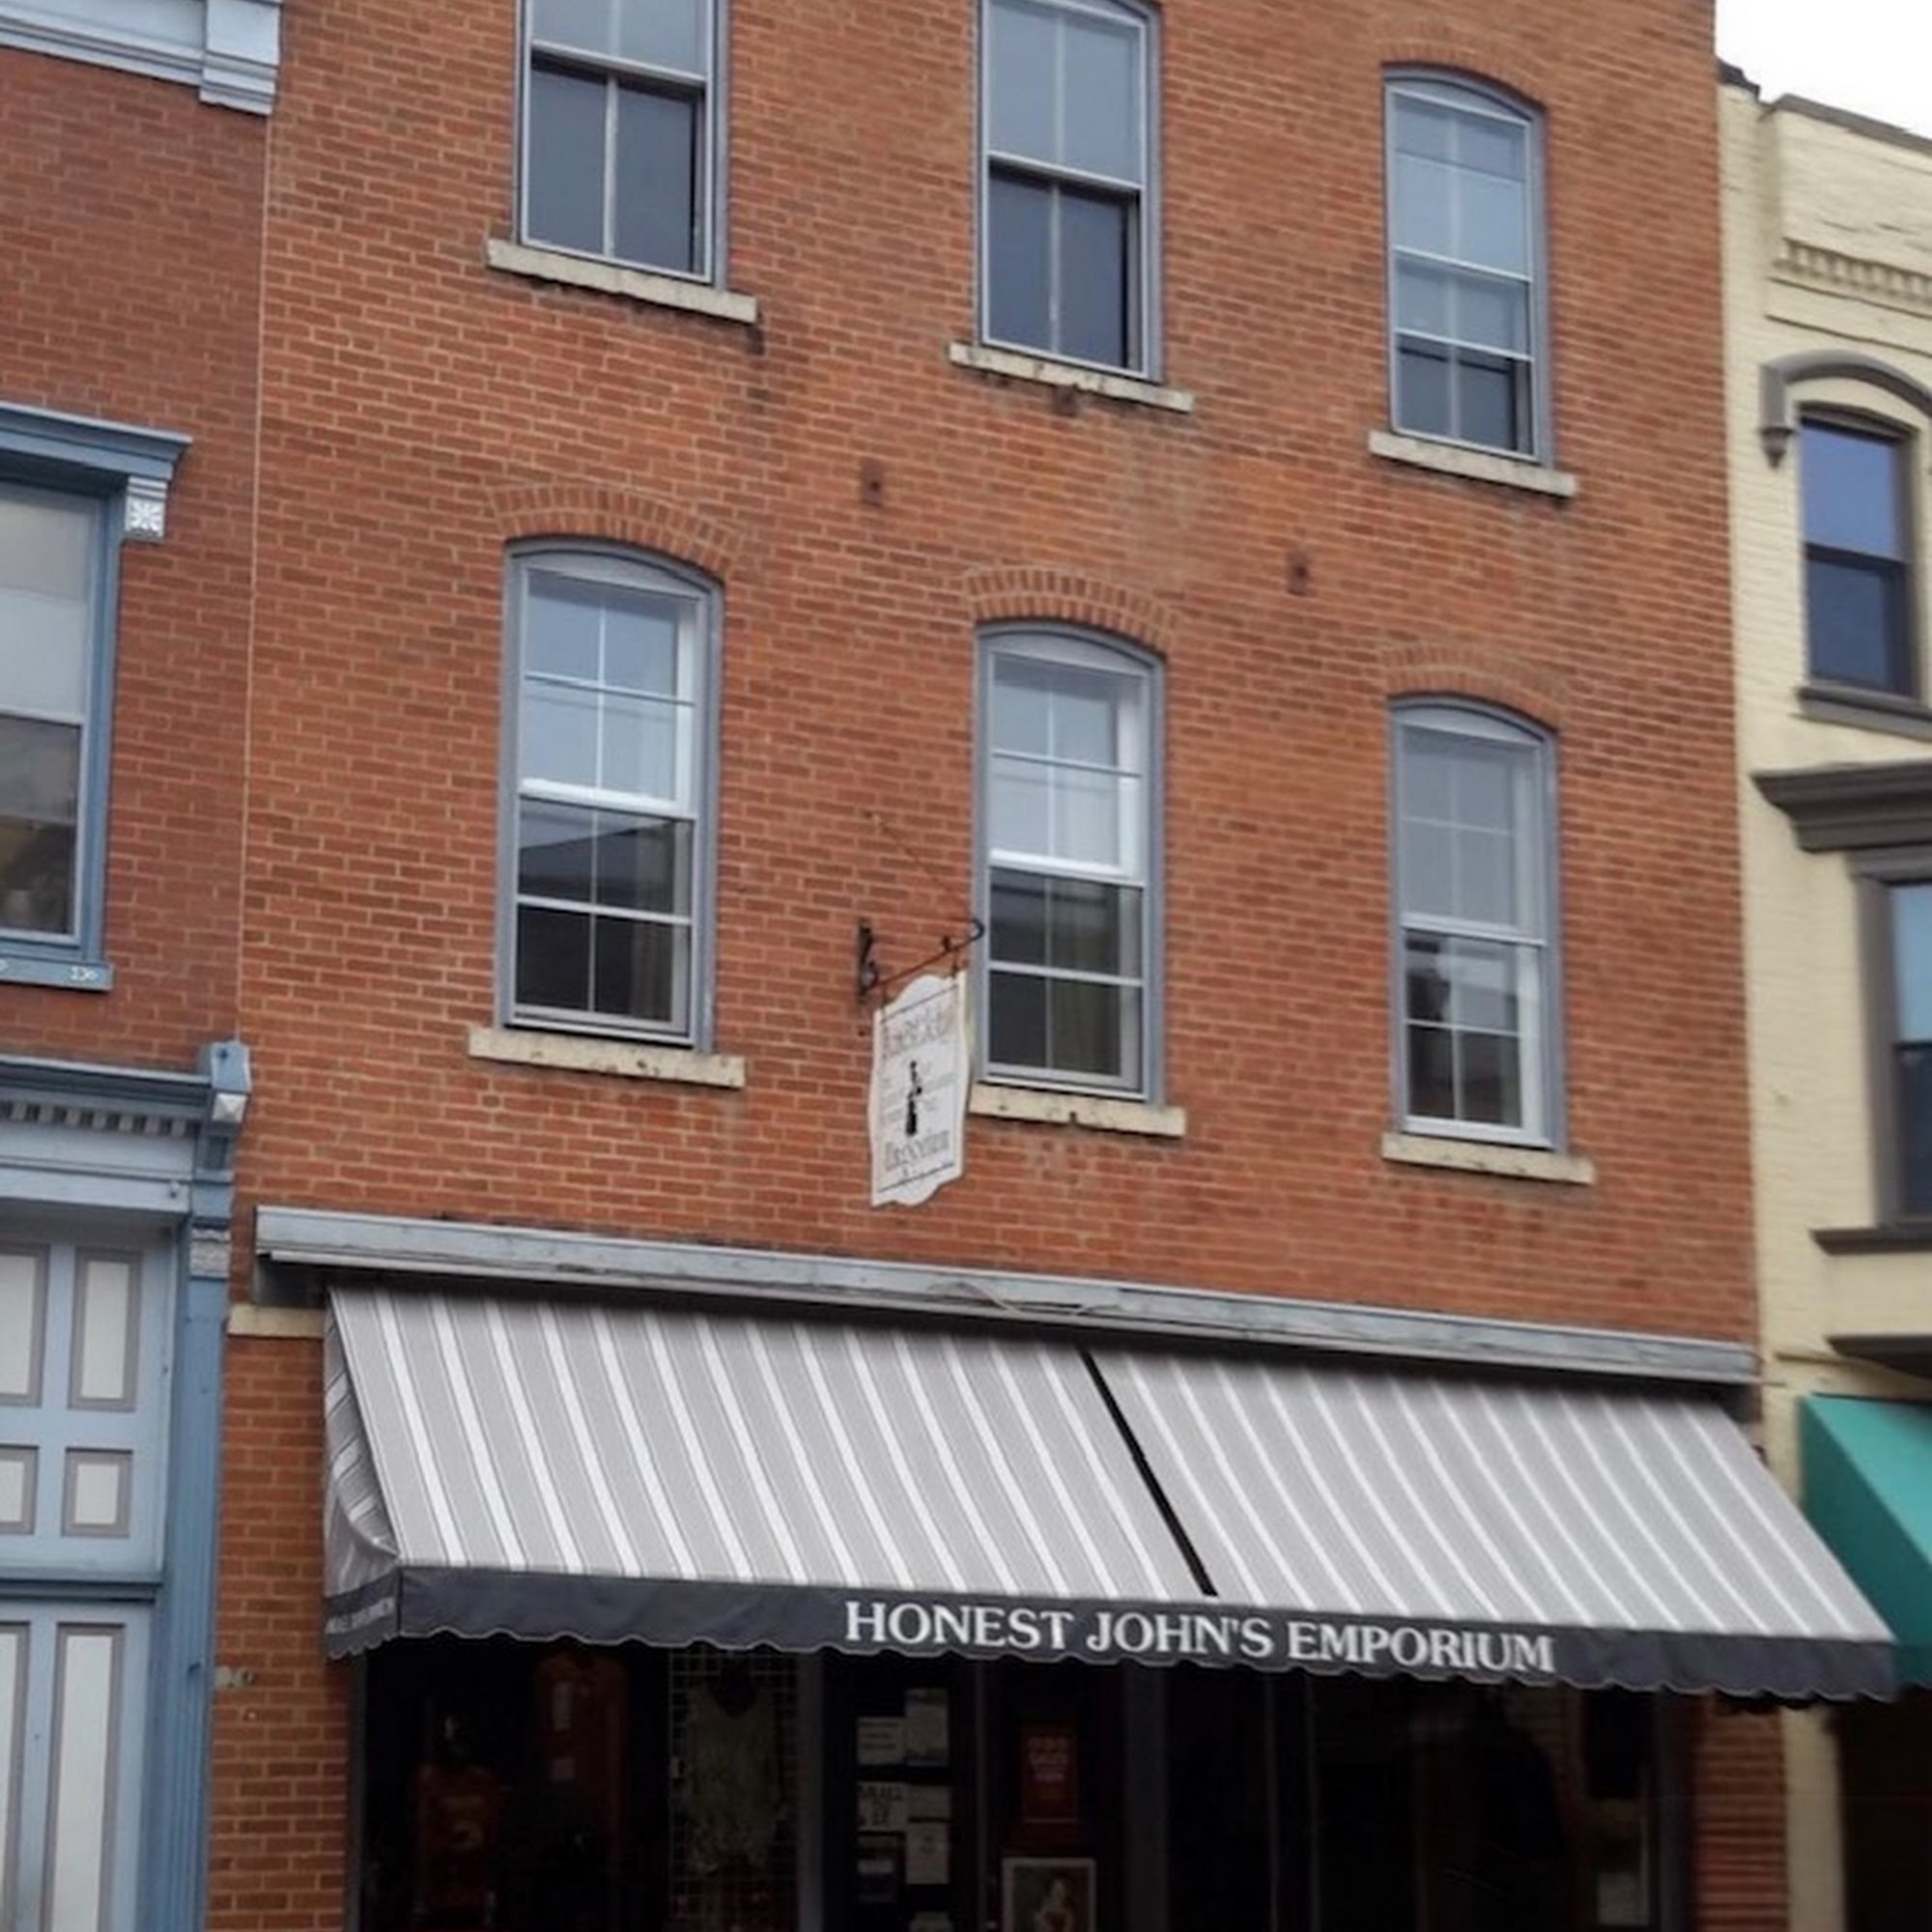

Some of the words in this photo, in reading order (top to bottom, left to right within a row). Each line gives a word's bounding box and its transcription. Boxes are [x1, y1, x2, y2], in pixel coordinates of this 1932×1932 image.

[845, 1601, 1073, 1649] HONEST
[1086, 1611, 1273, 1659] JOHN'S
[1287, 1620, 1556, 1673] EMPORIUM
